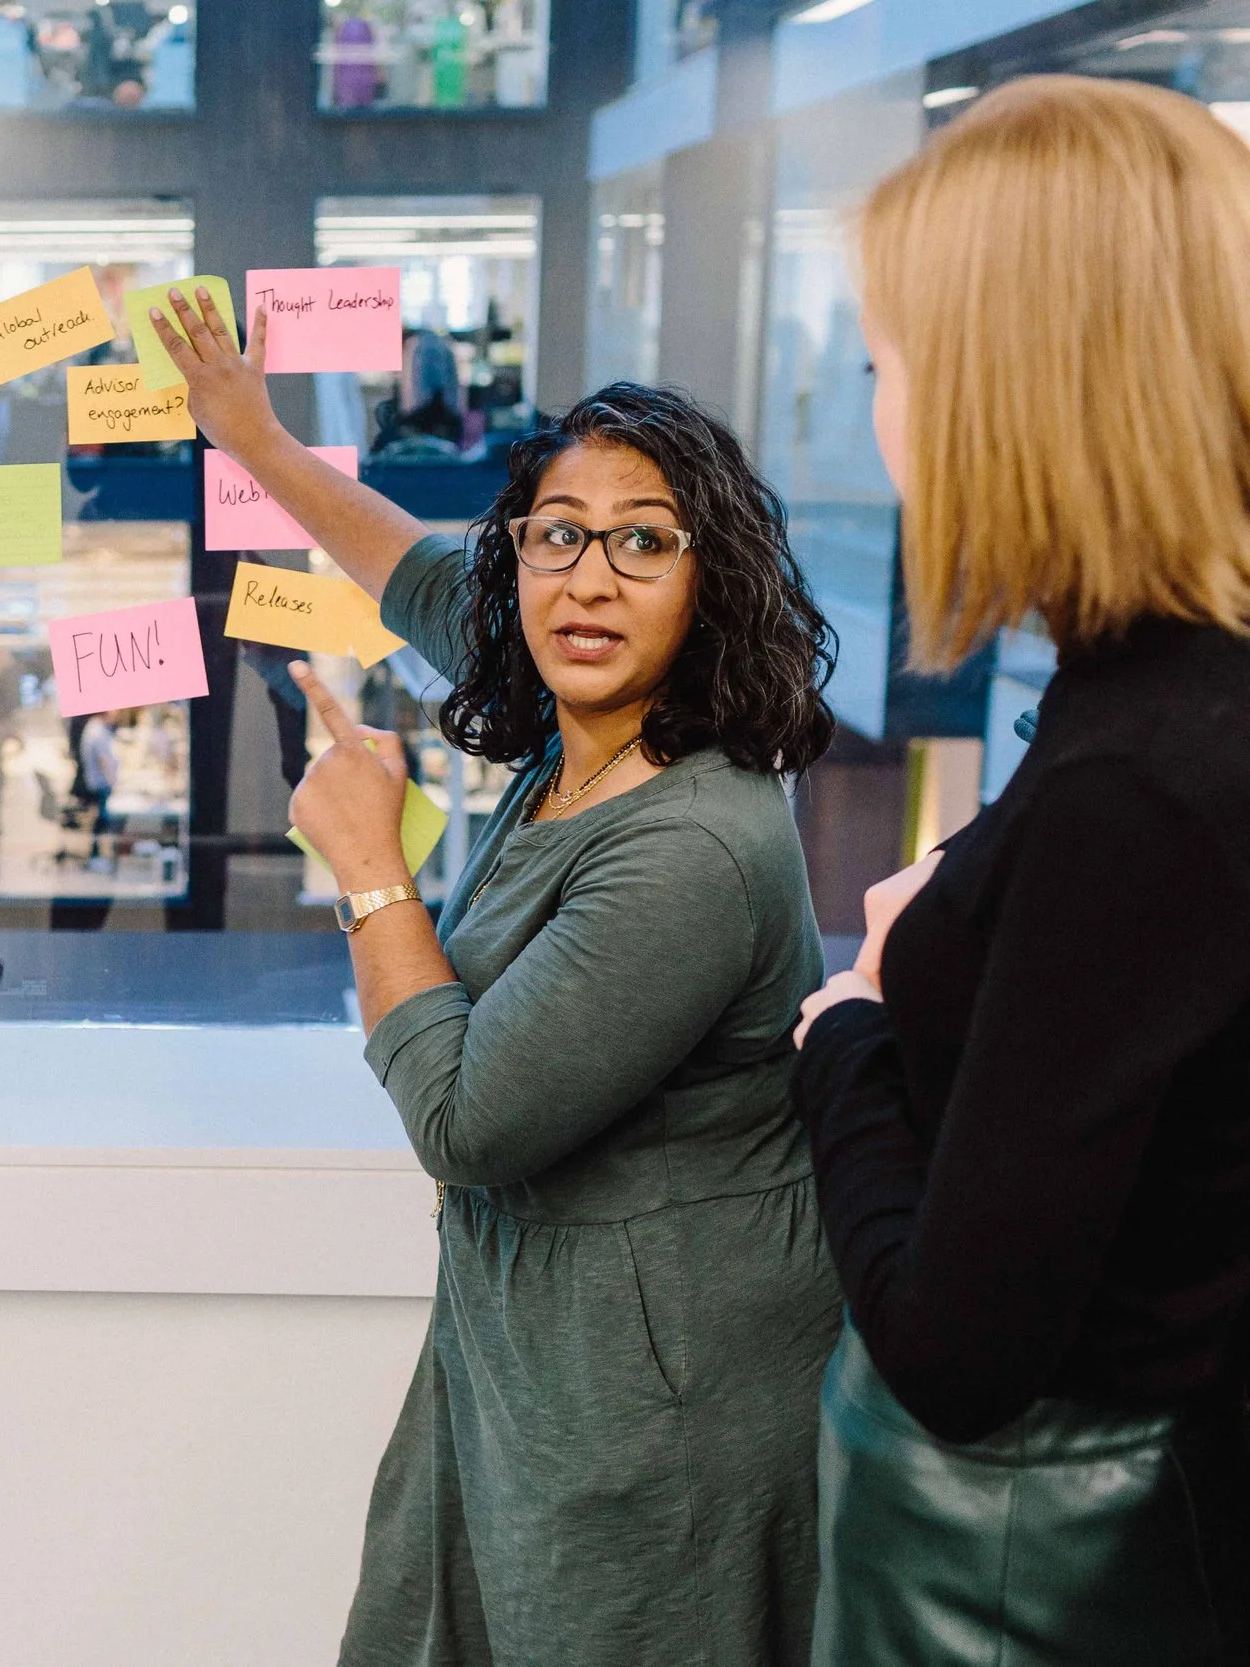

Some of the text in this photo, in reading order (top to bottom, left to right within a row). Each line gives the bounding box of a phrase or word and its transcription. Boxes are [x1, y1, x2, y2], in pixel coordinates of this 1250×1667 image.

[255, 288, 394, 319] Thought Leadership
[84, 377, 140, 395] Advisor
[88, 396, 184, 432] engagement?
[243, 580, 313, 614] Releases
[72, 619, 164, 693] FUN!
